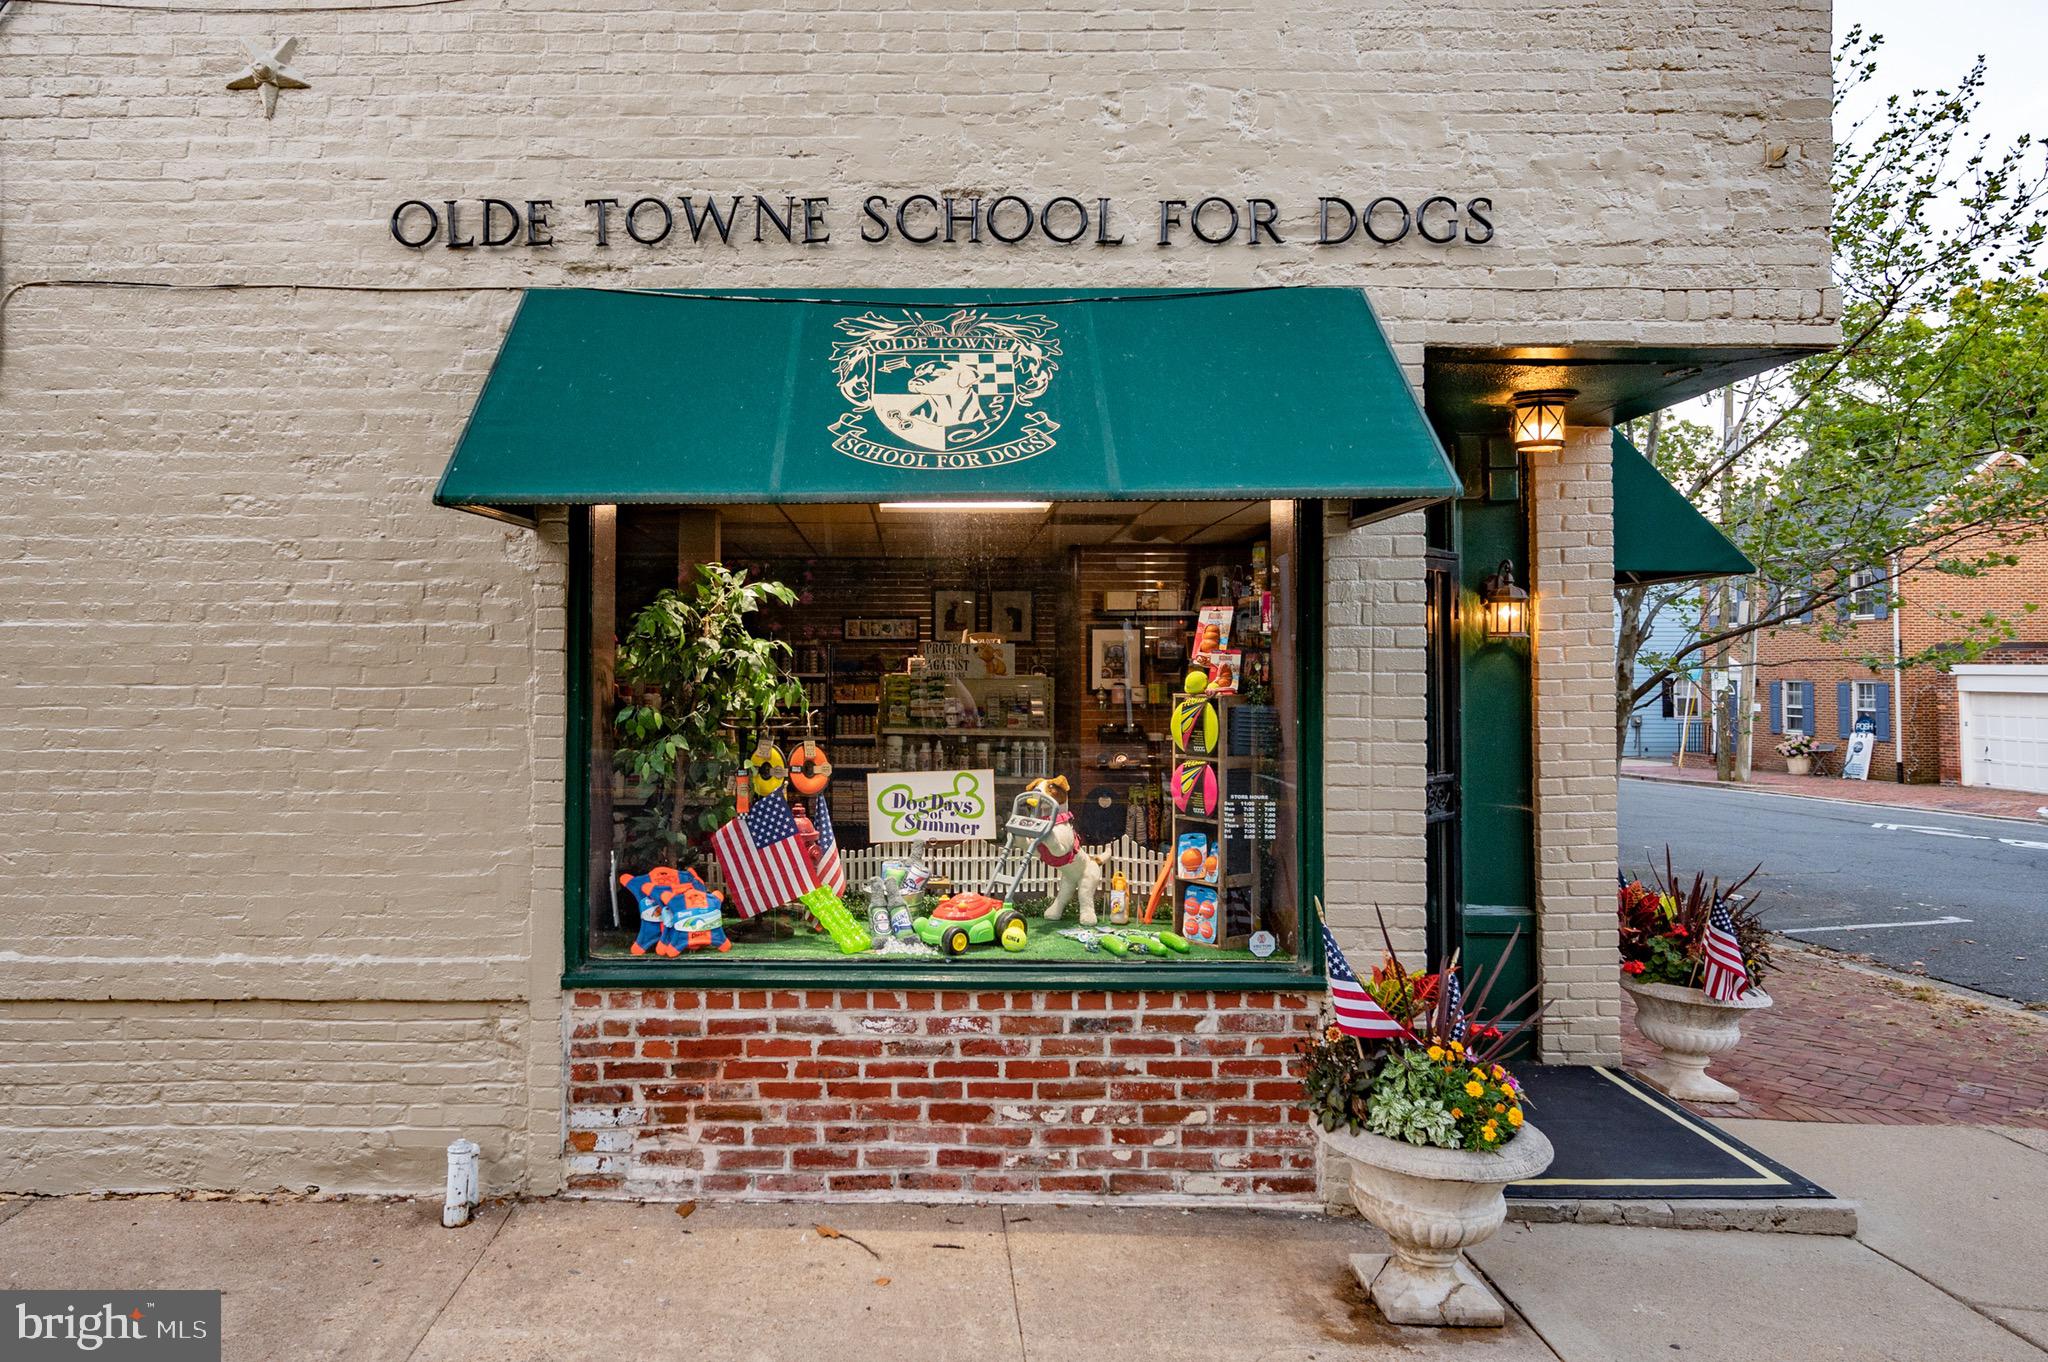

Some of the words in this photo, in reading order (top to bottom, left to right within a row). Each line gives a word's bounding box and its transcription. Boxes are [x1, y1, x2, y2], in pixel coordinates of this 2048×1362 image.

[390, 199, 554, 248] OLDE
[585, 195, 831, 247] TOWNE
[861, 194, 1125, 246] SCHOOL
[1157, 197, 1287, 245] FOR
[1317, 195, 1495, 246] DOGS
[875, 336, 929, 351] OLDE
[934, 336, 1010, 351] TOWNE
[840, 436, 928, 468] SCHOOL
[937, 450, 983, 468] FOR
[991, 434, 1047, 463] DOGS
[926, 643, 971, 655] PROTECT
[927, 659, 970, 671] AGAINST
[892, 791, 929, 820] Dog
[930, 792, 973, 816] Days
[930, 808, 944, 820] of
[904, 813, 980, 836] Summer
